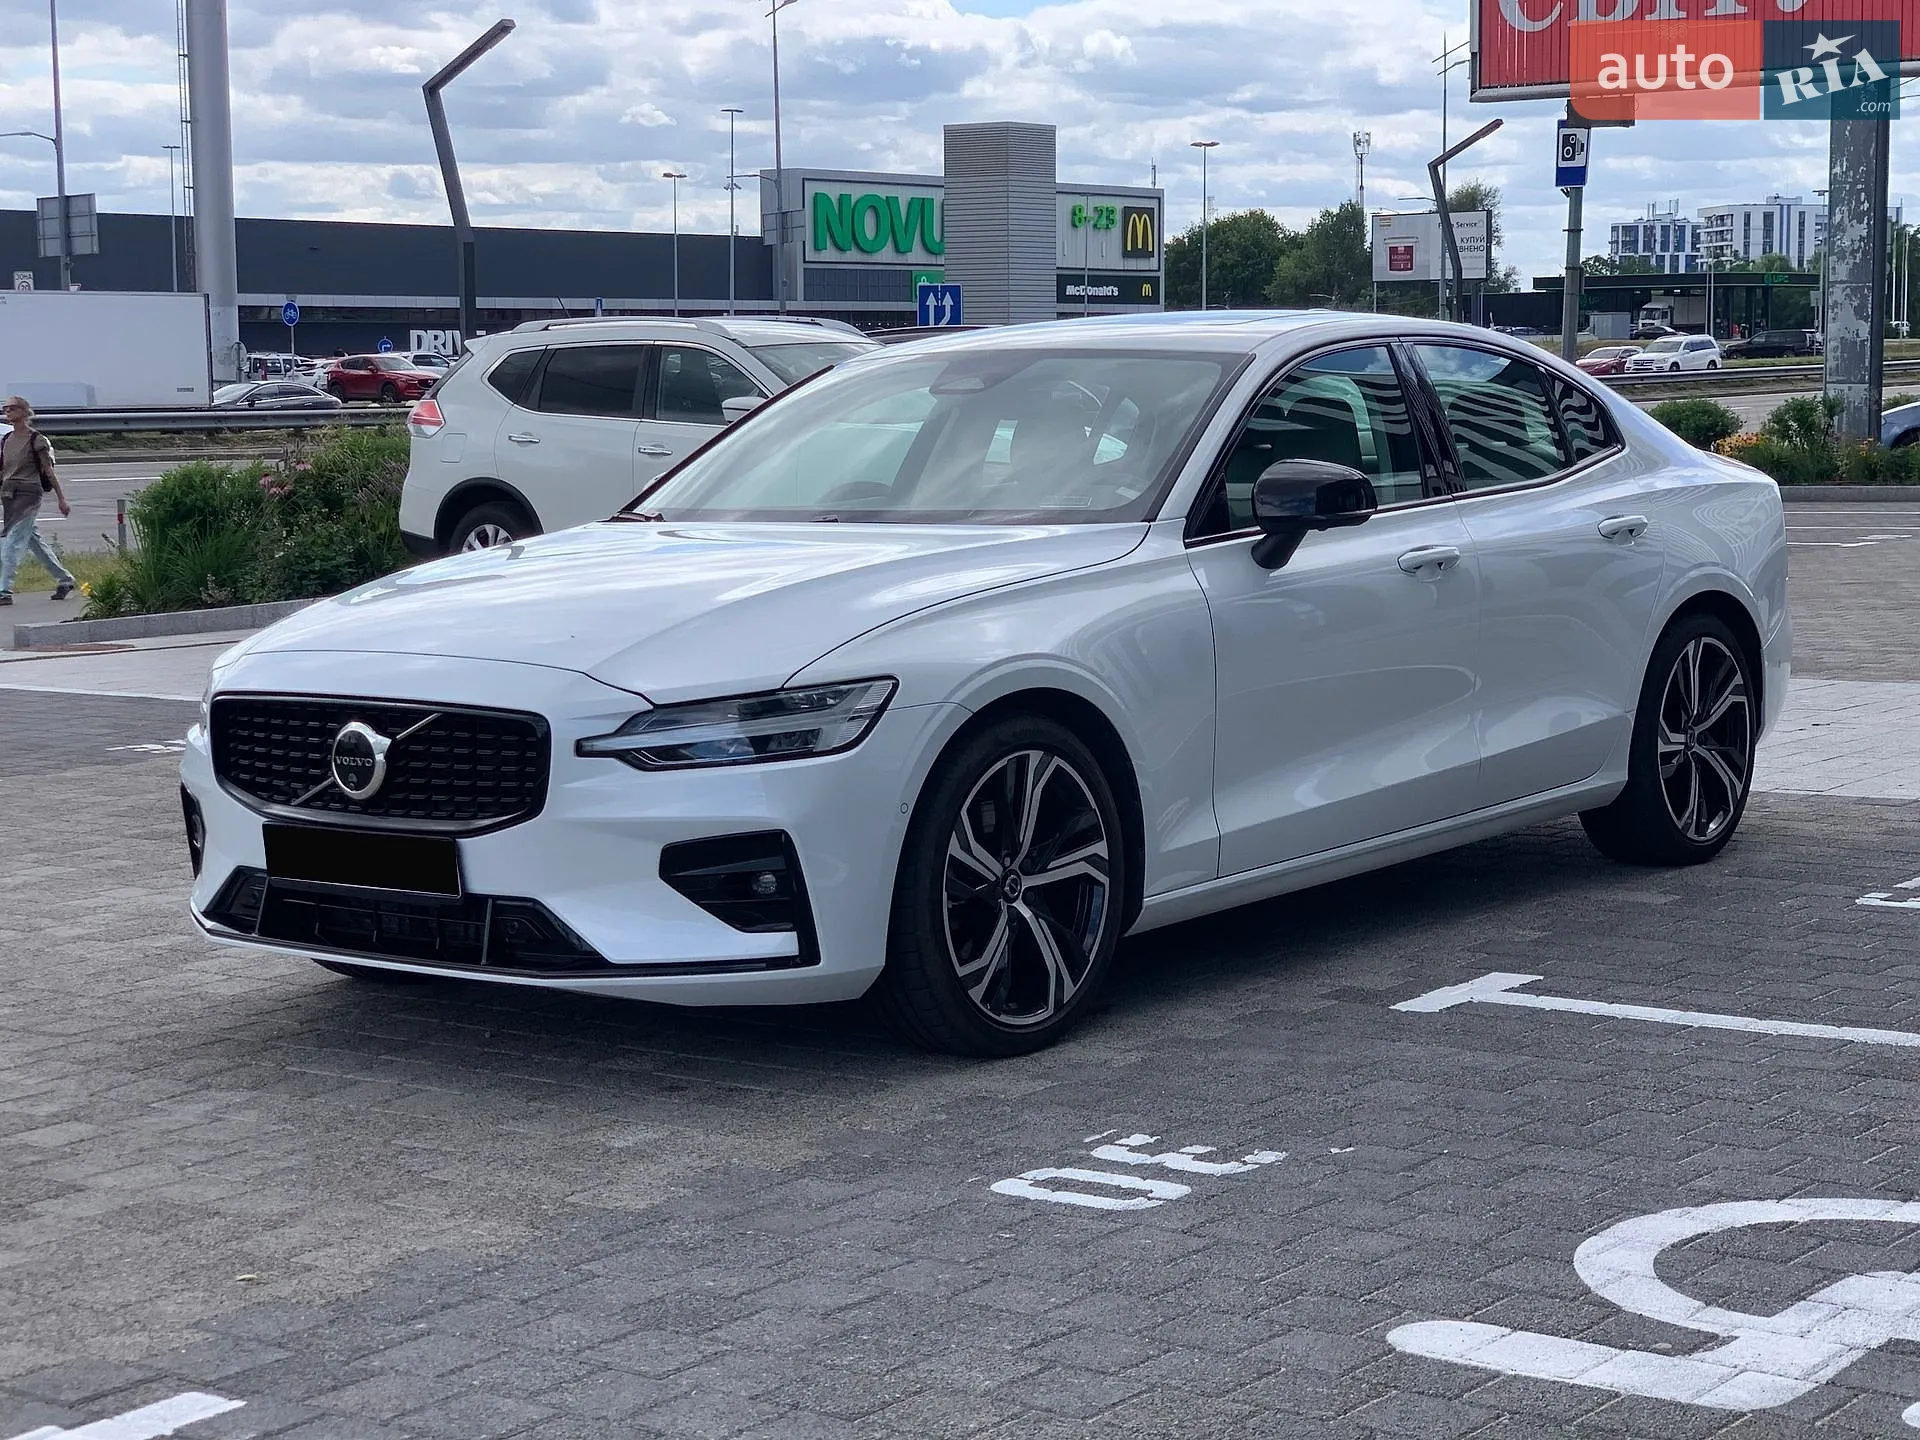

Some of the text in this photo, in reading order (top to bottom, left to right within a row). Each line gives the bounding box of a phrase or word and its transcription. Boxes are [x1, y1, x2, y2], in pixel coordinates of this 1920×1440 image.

[1072, 204, 1117, 230] 8-23
[1460, 234, 1486, 244] КУПУЙ
[1065, 285, 1119, 297] McDonald's
[335, 755, 374, 767] VOLVO
